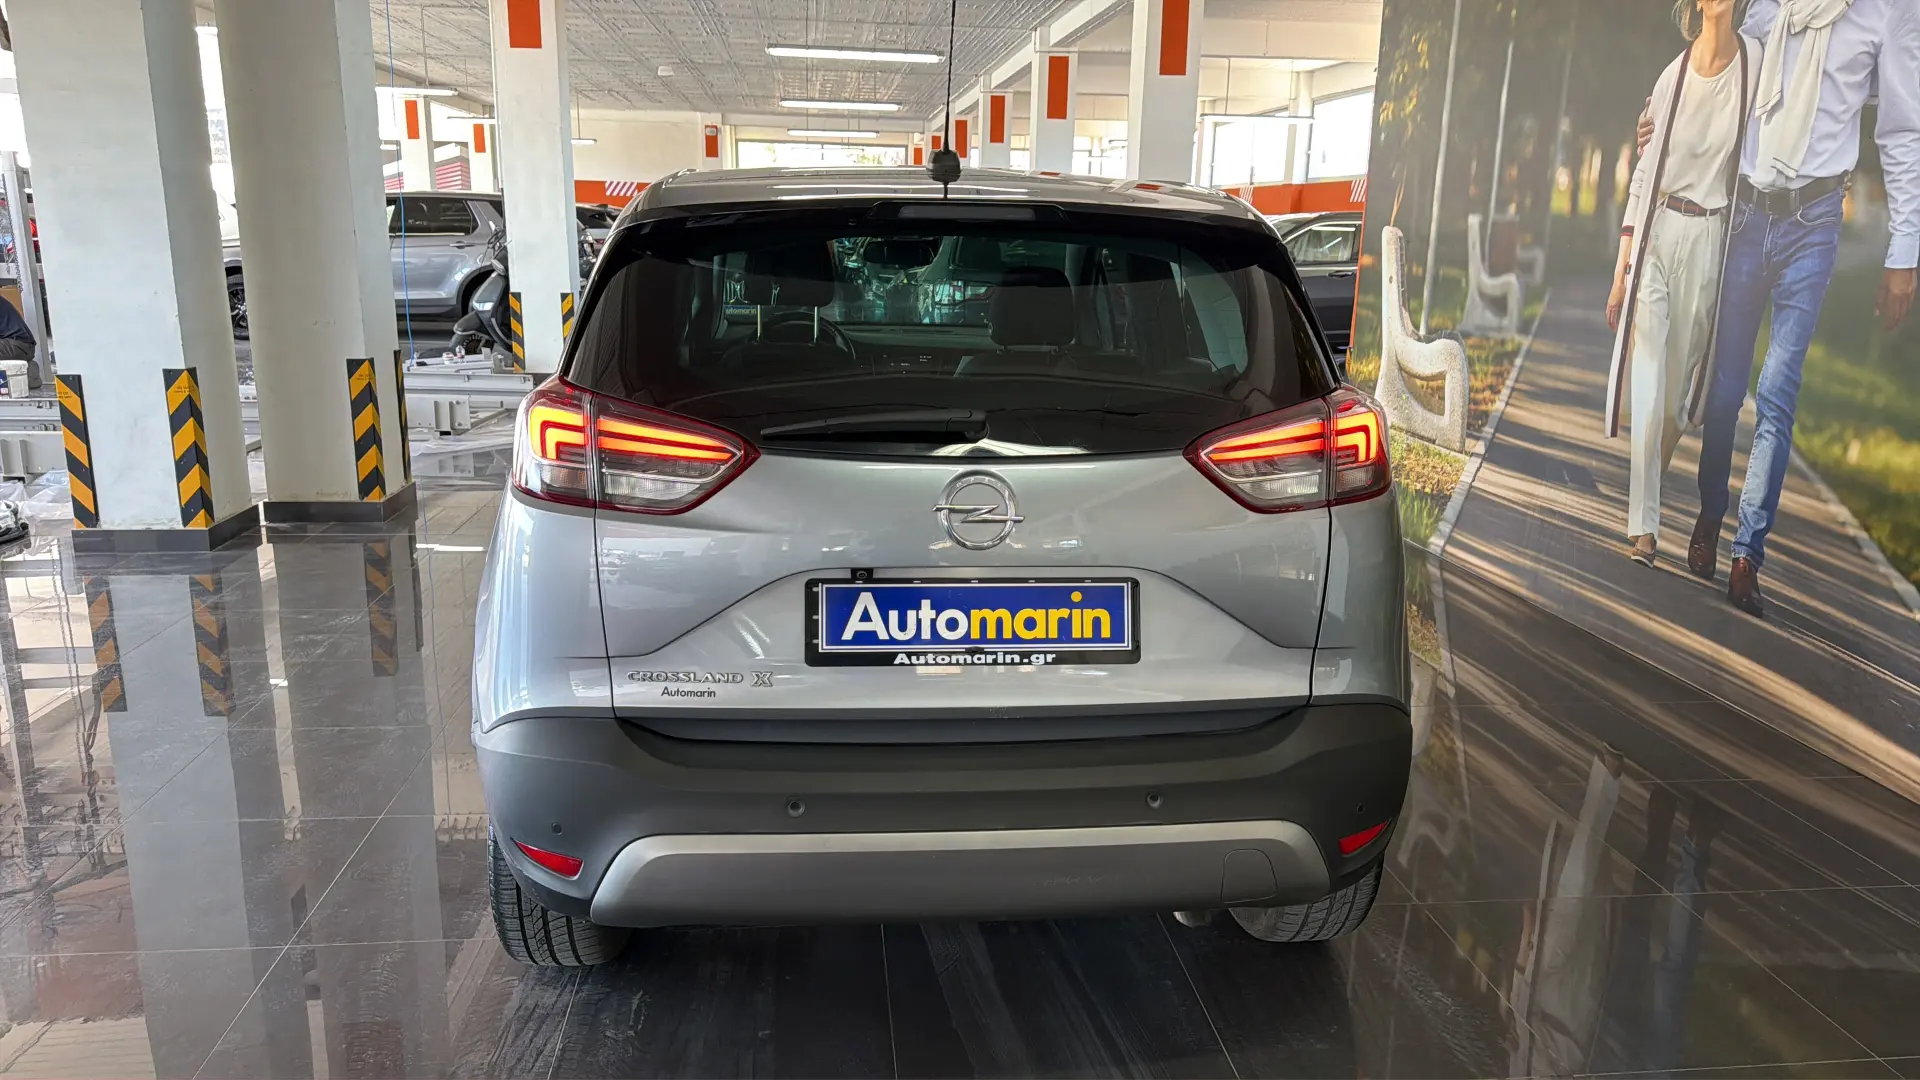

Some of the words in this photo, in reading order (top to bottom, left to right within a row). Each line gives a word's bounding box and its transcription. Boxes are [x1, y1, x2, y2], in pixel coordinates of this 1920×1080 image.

[725, 306, 757, 316] utomarin
[841, 592, 1111, 640] Automarin
[893, 652, 1056, 665] Automarin.gr
[627, 671, 745, 684] CROSSLAND
[751, 671, 774, 688] X
[660, 686, 717, 699] Automarin
